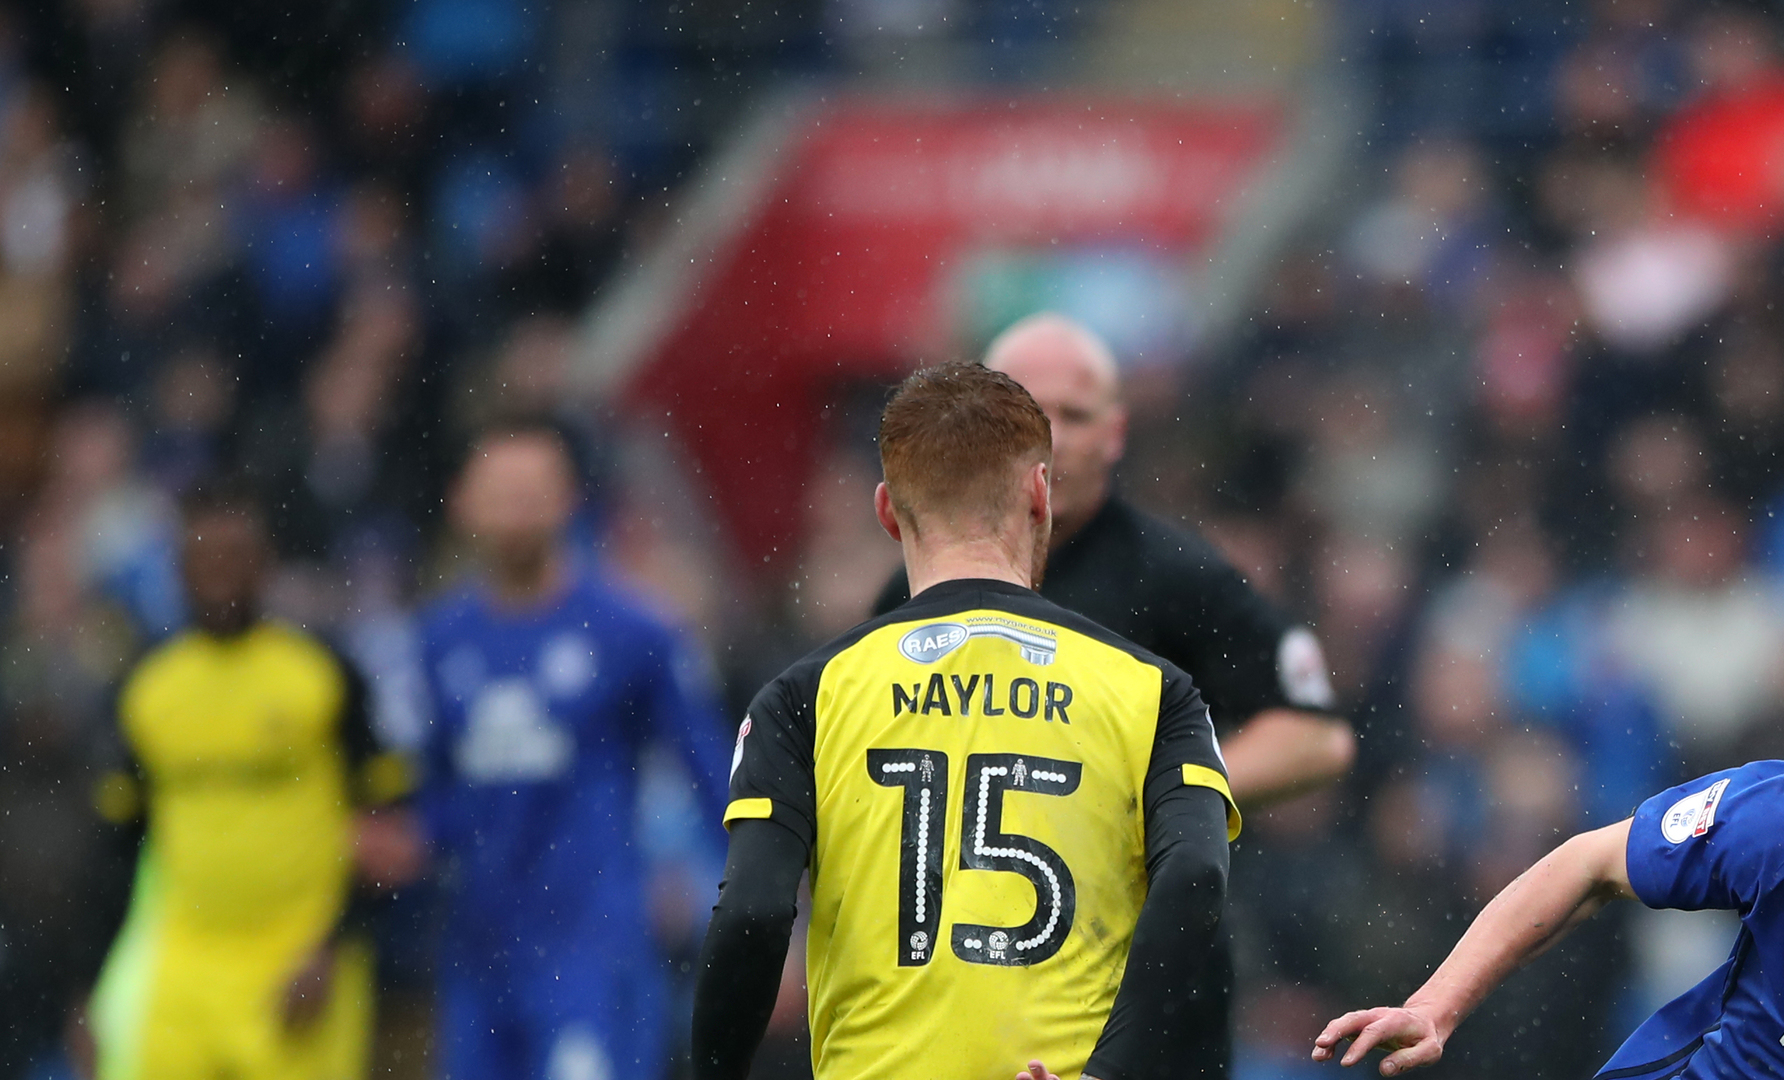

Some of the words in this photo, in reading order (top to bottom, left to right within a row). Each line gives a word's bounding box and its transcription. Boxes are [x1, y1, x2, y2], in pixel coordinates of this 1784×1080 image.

[908, 630, 964, 654] RAES
[891, 672, 1074, 726] NAYLOR
[866, 748, 1082, 967] 15
[911, 951, 925, 960] EFL
[990, 951, 1006, 960] EFL
